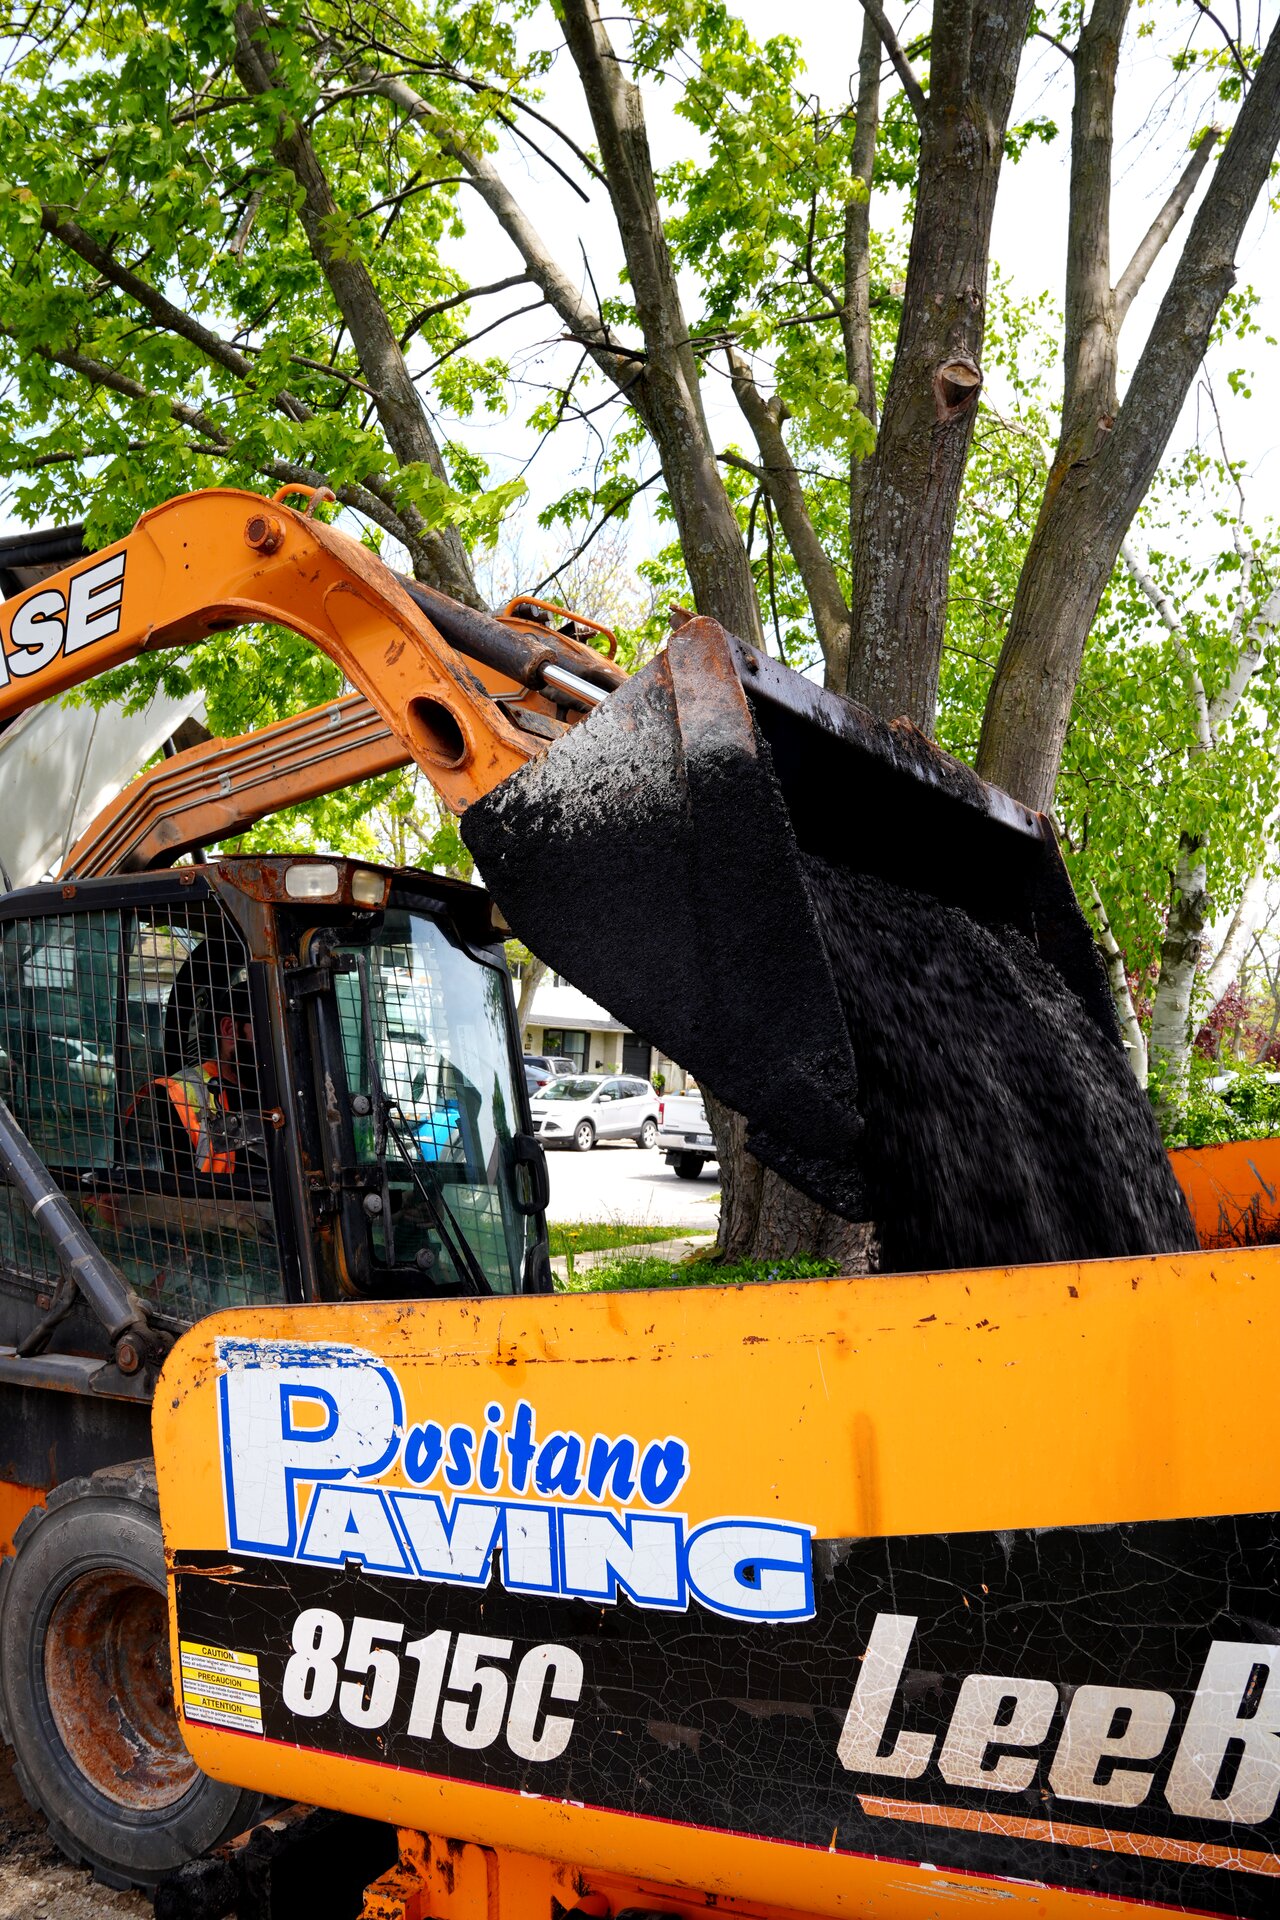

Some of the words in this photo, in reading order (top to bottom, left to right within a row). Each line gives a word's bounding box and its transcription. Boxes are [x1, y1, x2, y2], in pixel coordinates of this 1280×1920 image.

[0, 549, 128, 689] SE
[215, 1336, 691, 1559] Positano
[198, 1672, 242, 1687] PRECAUCION
[202, 1647, 234, 1660] CAUTION
[282, 1608, 585, 1762] 8515C
[202, 1698, 242, 1712] ATTENTION
